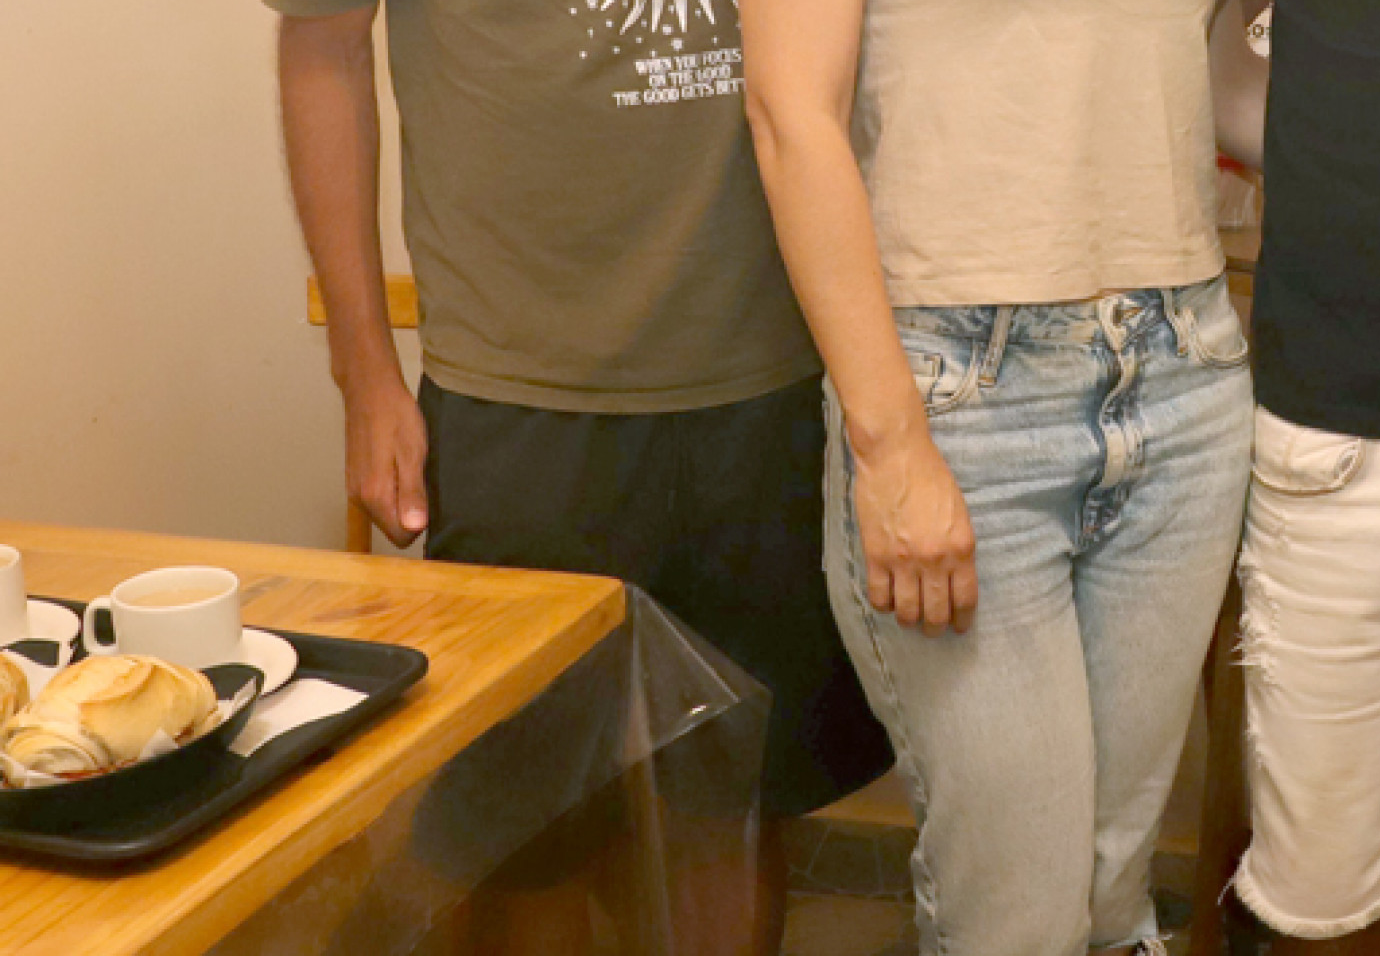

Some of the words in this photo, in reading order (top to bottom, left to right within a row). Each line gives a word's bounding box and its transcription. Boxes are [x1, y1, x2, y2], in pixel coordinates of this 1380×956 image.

[612, 90, 642, 108] THE
[643, 87, 680, 104] GOOD
[681, 83, 715, 100] GETS
